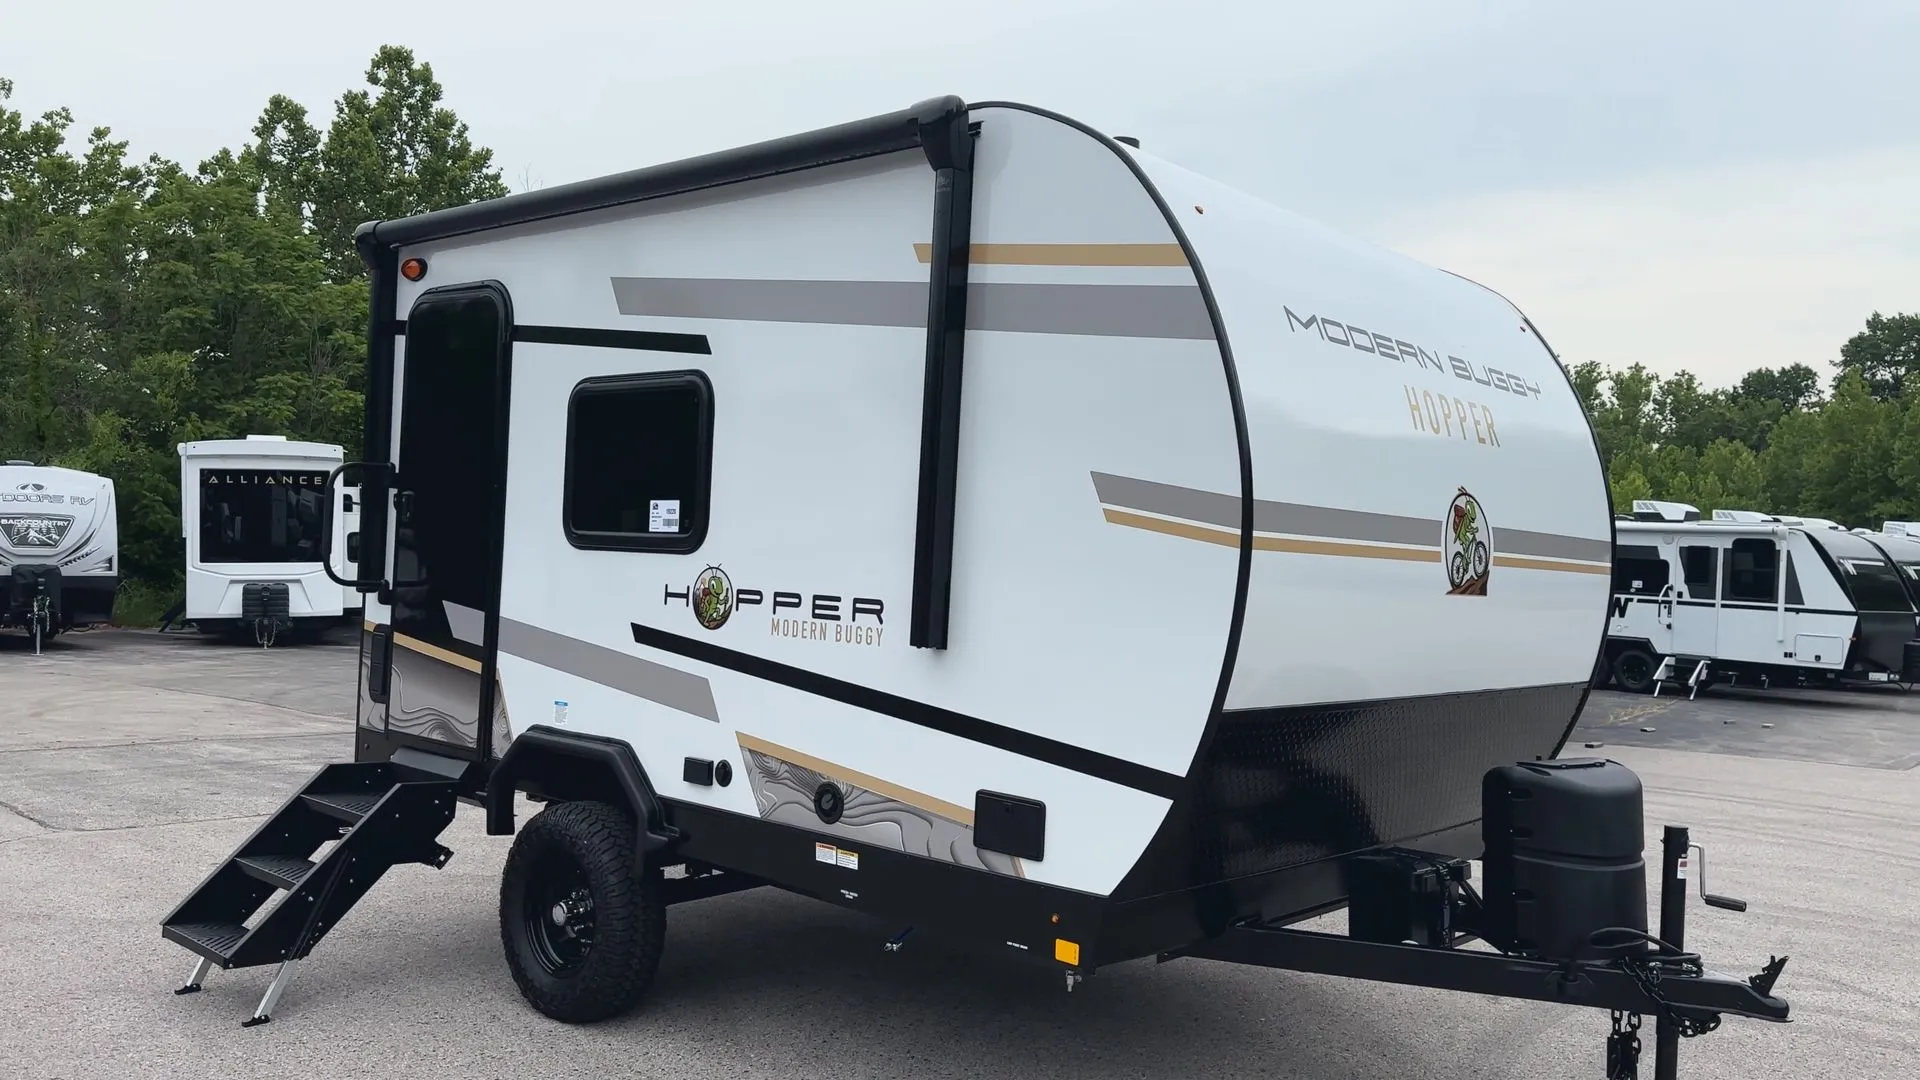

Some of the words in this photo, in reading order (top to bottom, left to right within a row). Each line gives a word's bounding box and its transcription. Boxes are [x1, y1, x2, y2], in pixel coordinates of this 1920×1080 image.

[1283, 305, 1445, 374] MODERN
[1447, 355, 1542, 400] BUGGY
[1404, 384, 1501, 448] HOPPER
[208, 475, 323, 485] ALLIANCE
[0, 493, 64, 504] DOORS
[70, 495, 96, 506] RV
[0, 518, 70, 527] BACKCOUNTRY
[664, 567, 884, 630] HOPPER
[771, 617, 828, 641] MODERN
[835, 624, 884, 647] BUGGY
